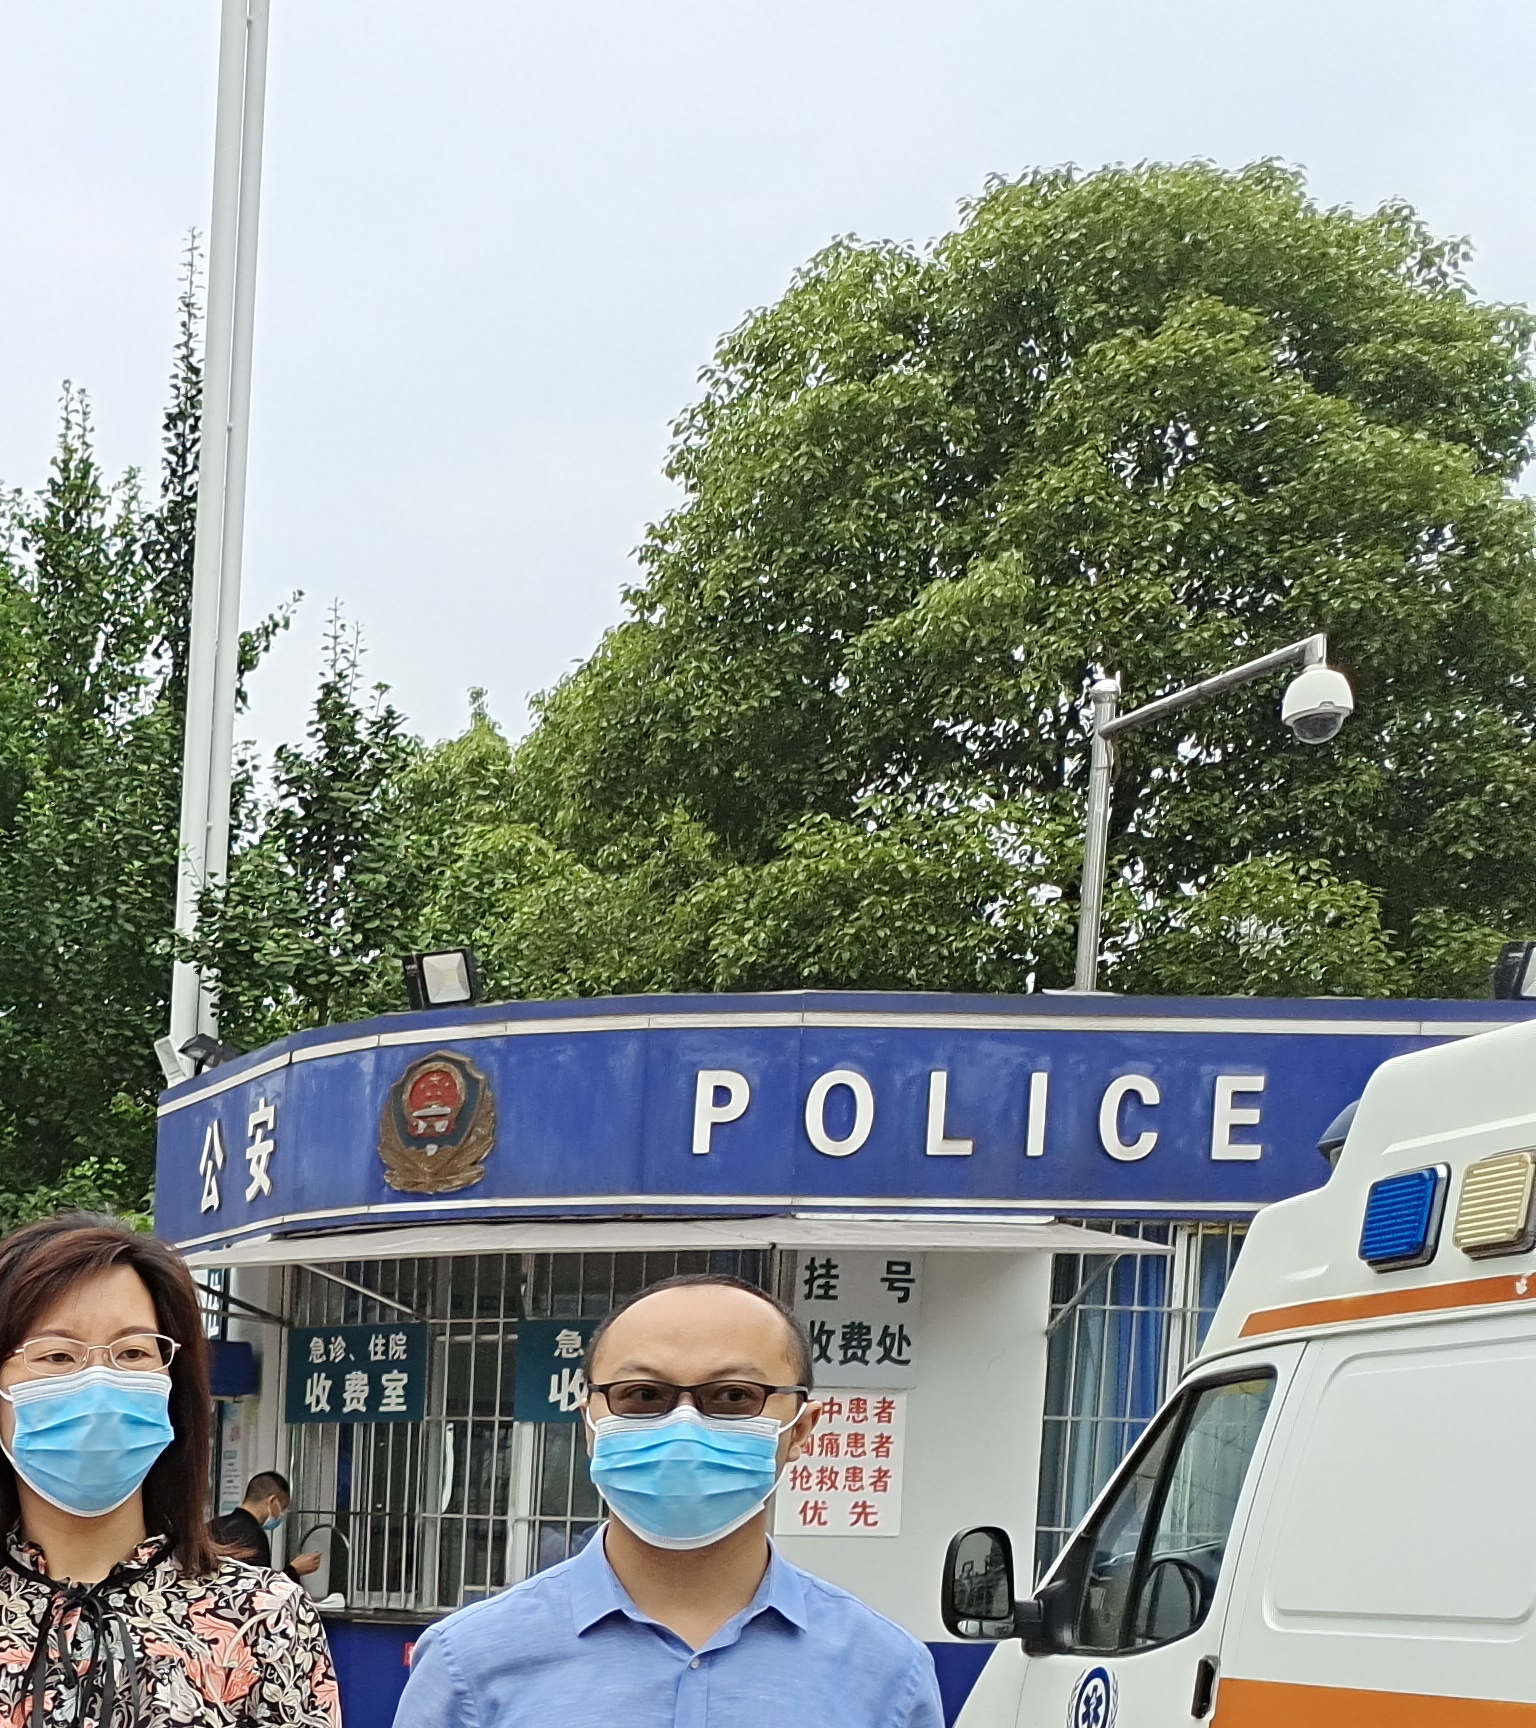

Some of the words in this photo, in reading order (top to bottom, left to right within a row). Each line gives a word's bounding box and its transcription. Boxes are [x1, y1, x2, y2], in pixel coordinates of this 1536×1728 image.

[691, 1068, 1267, 1162] POLICE
[199, 1096, 276, 1213] 公安
[304, 1369, 409, 1414] 收费室
[808, 1396, 896, 1424] 中患者
[789, 1464, 893, 1494] 抢救患者
[798, 1499, 880, 1528] 优先
